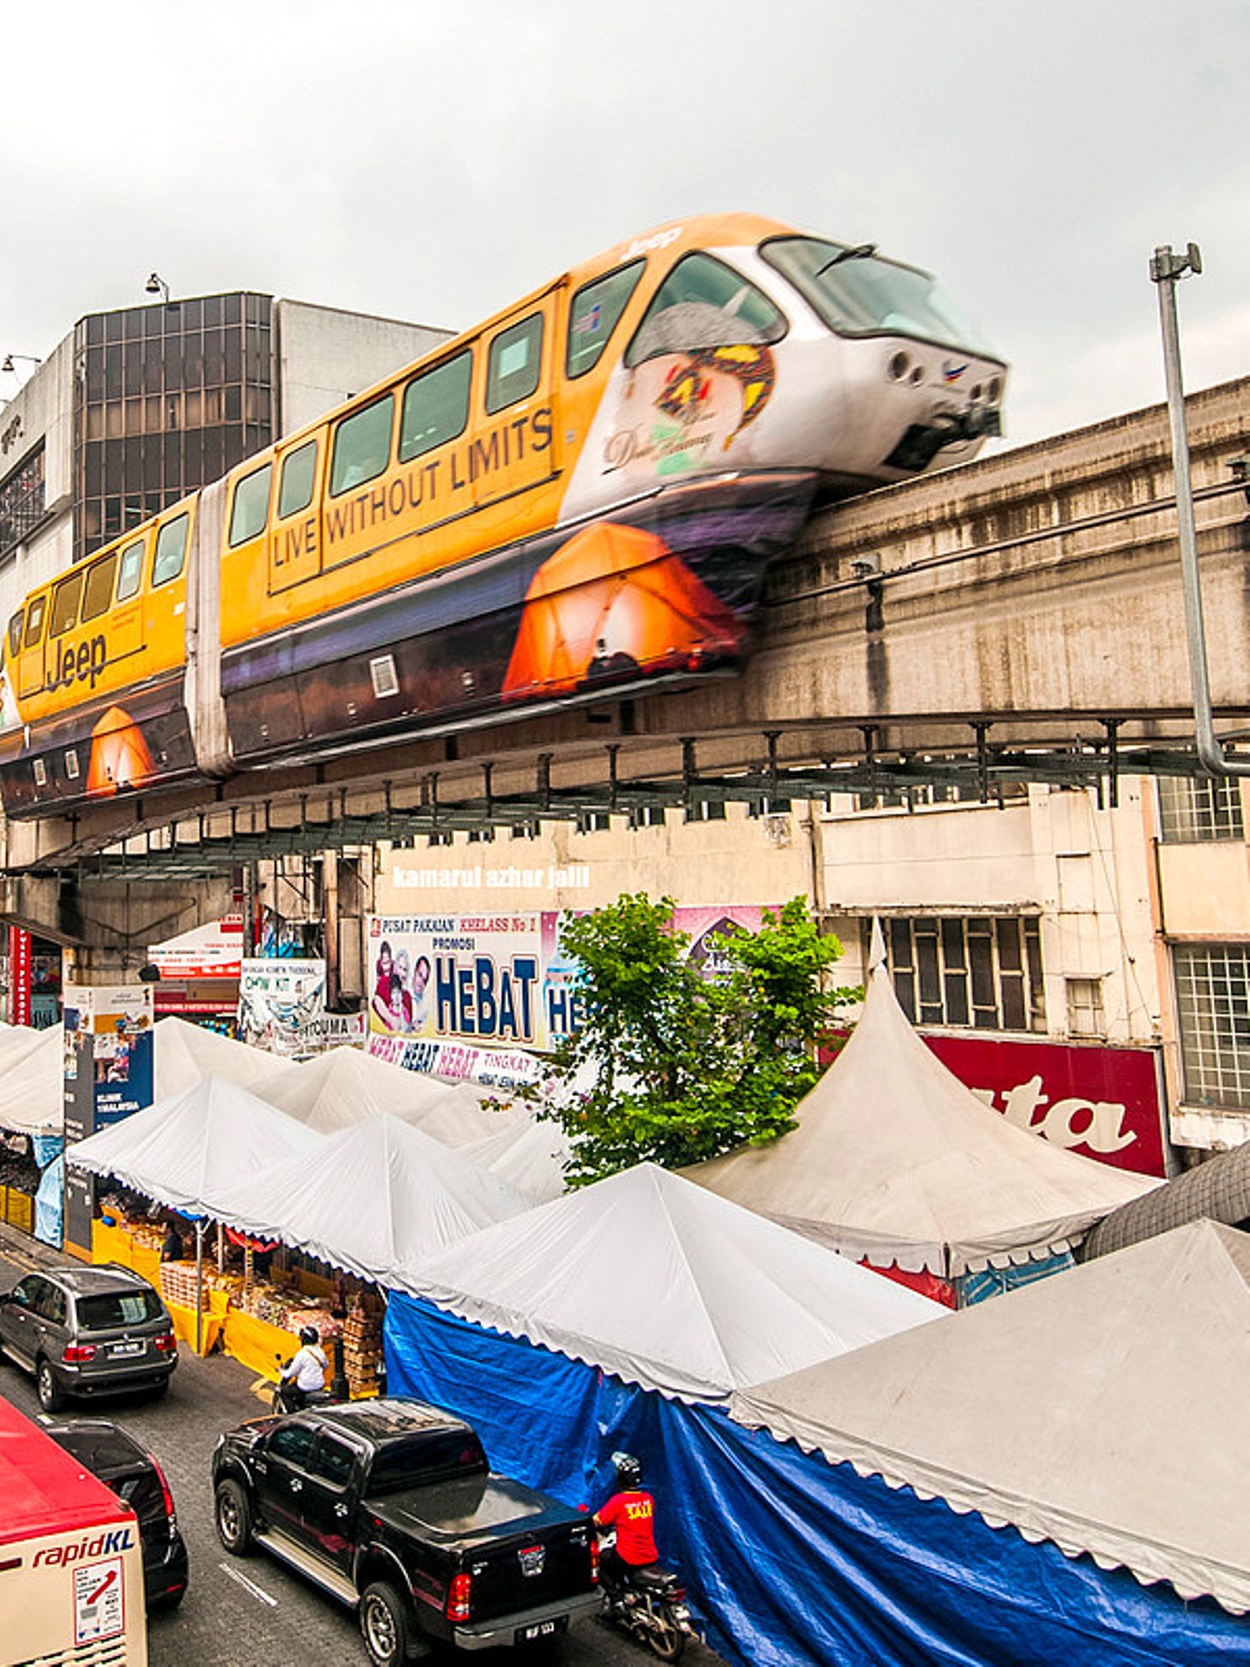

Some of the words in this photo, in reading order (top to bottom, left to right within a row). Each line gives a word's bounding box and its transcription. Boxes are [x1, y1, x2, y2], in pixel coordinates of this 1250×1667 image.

[273, 517, 316, 568] LIVE
[326, 460, 441, 545] WITHOUT
[450, 407, 554, 491] LIMITS
[47, 634, 106, 693] Jeep
[383, 919, 411, 933] PUSAT
[413, 918, 455, 932] PAKAIAN
[459, 918, 509, 933] KHELASS
[432, 938, 476, 950] PROMOSI
[484, 1052, 530, 1073] TINGKAT
[32, 1529, 135, 1568] rapidKL
